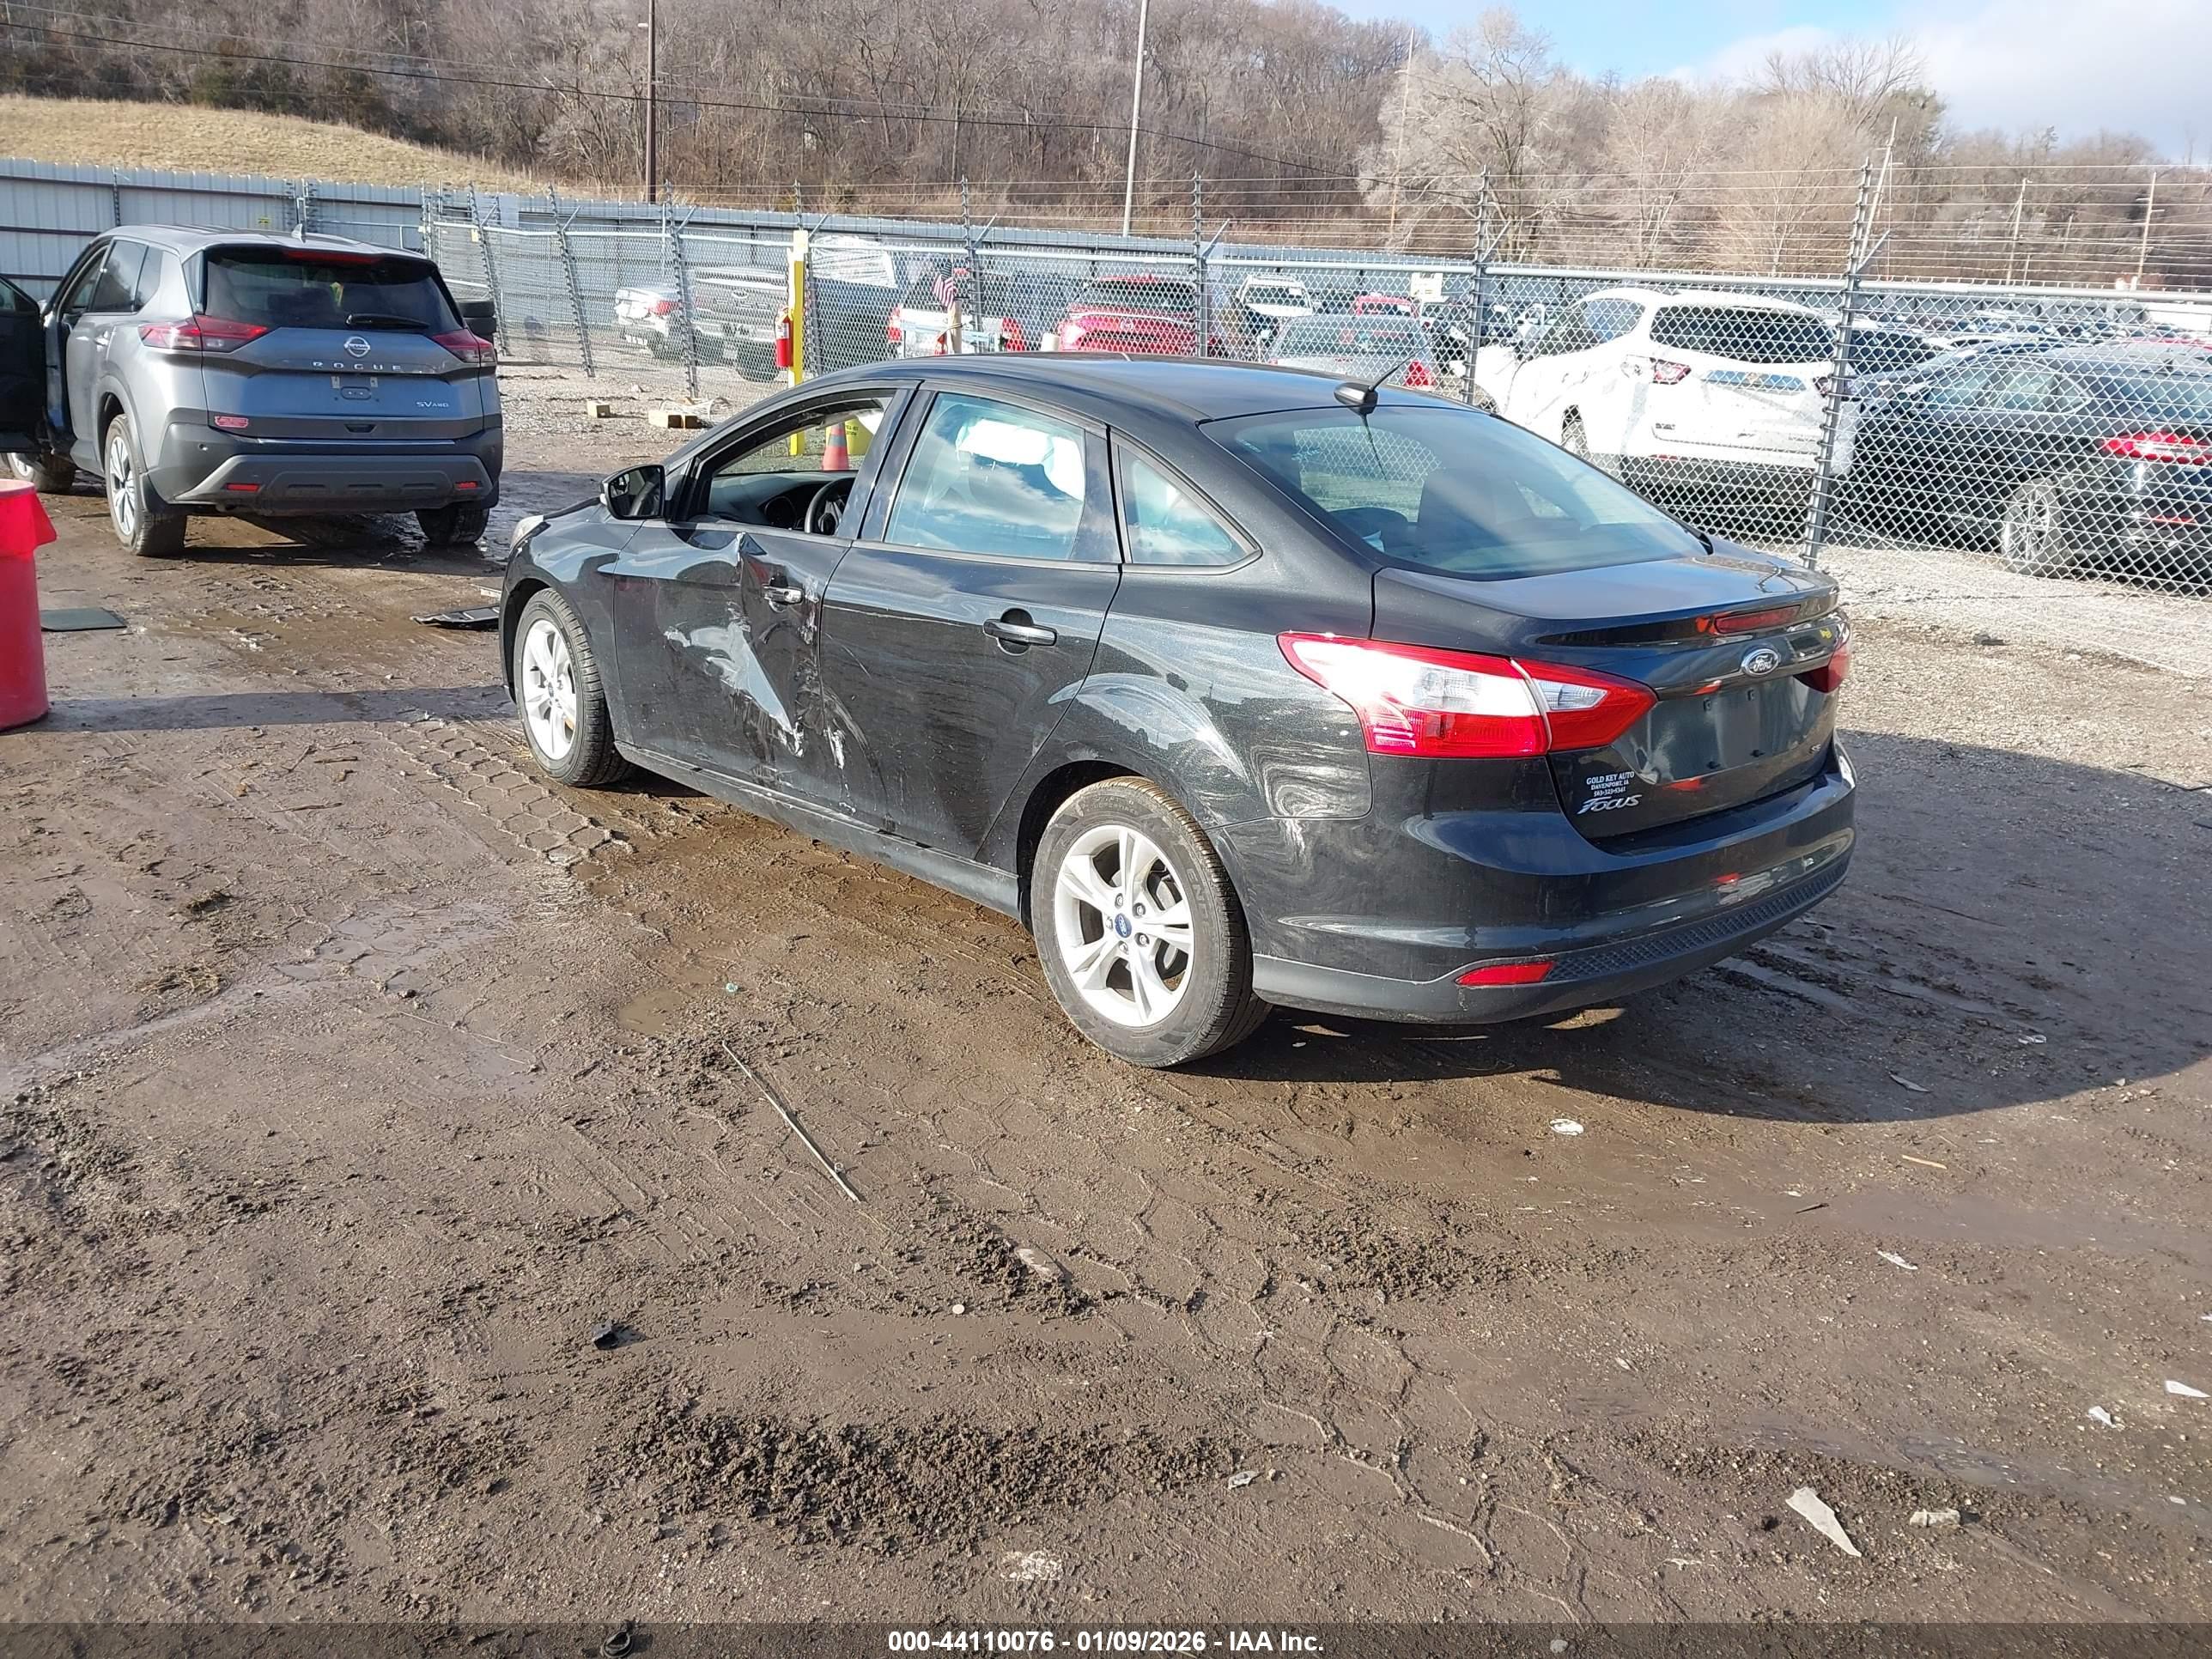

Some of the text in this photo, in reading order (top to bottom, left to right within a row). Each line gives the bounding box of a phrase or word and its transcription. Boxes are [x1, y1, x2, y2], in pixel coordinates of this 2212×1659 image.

[313, 361, 402, 371] ROGUE
[1753, 654, 1773, 672] Ford
[1586, 775, 1605, 785] GOLD
[1618, 771, 1635, 780] AUTO
